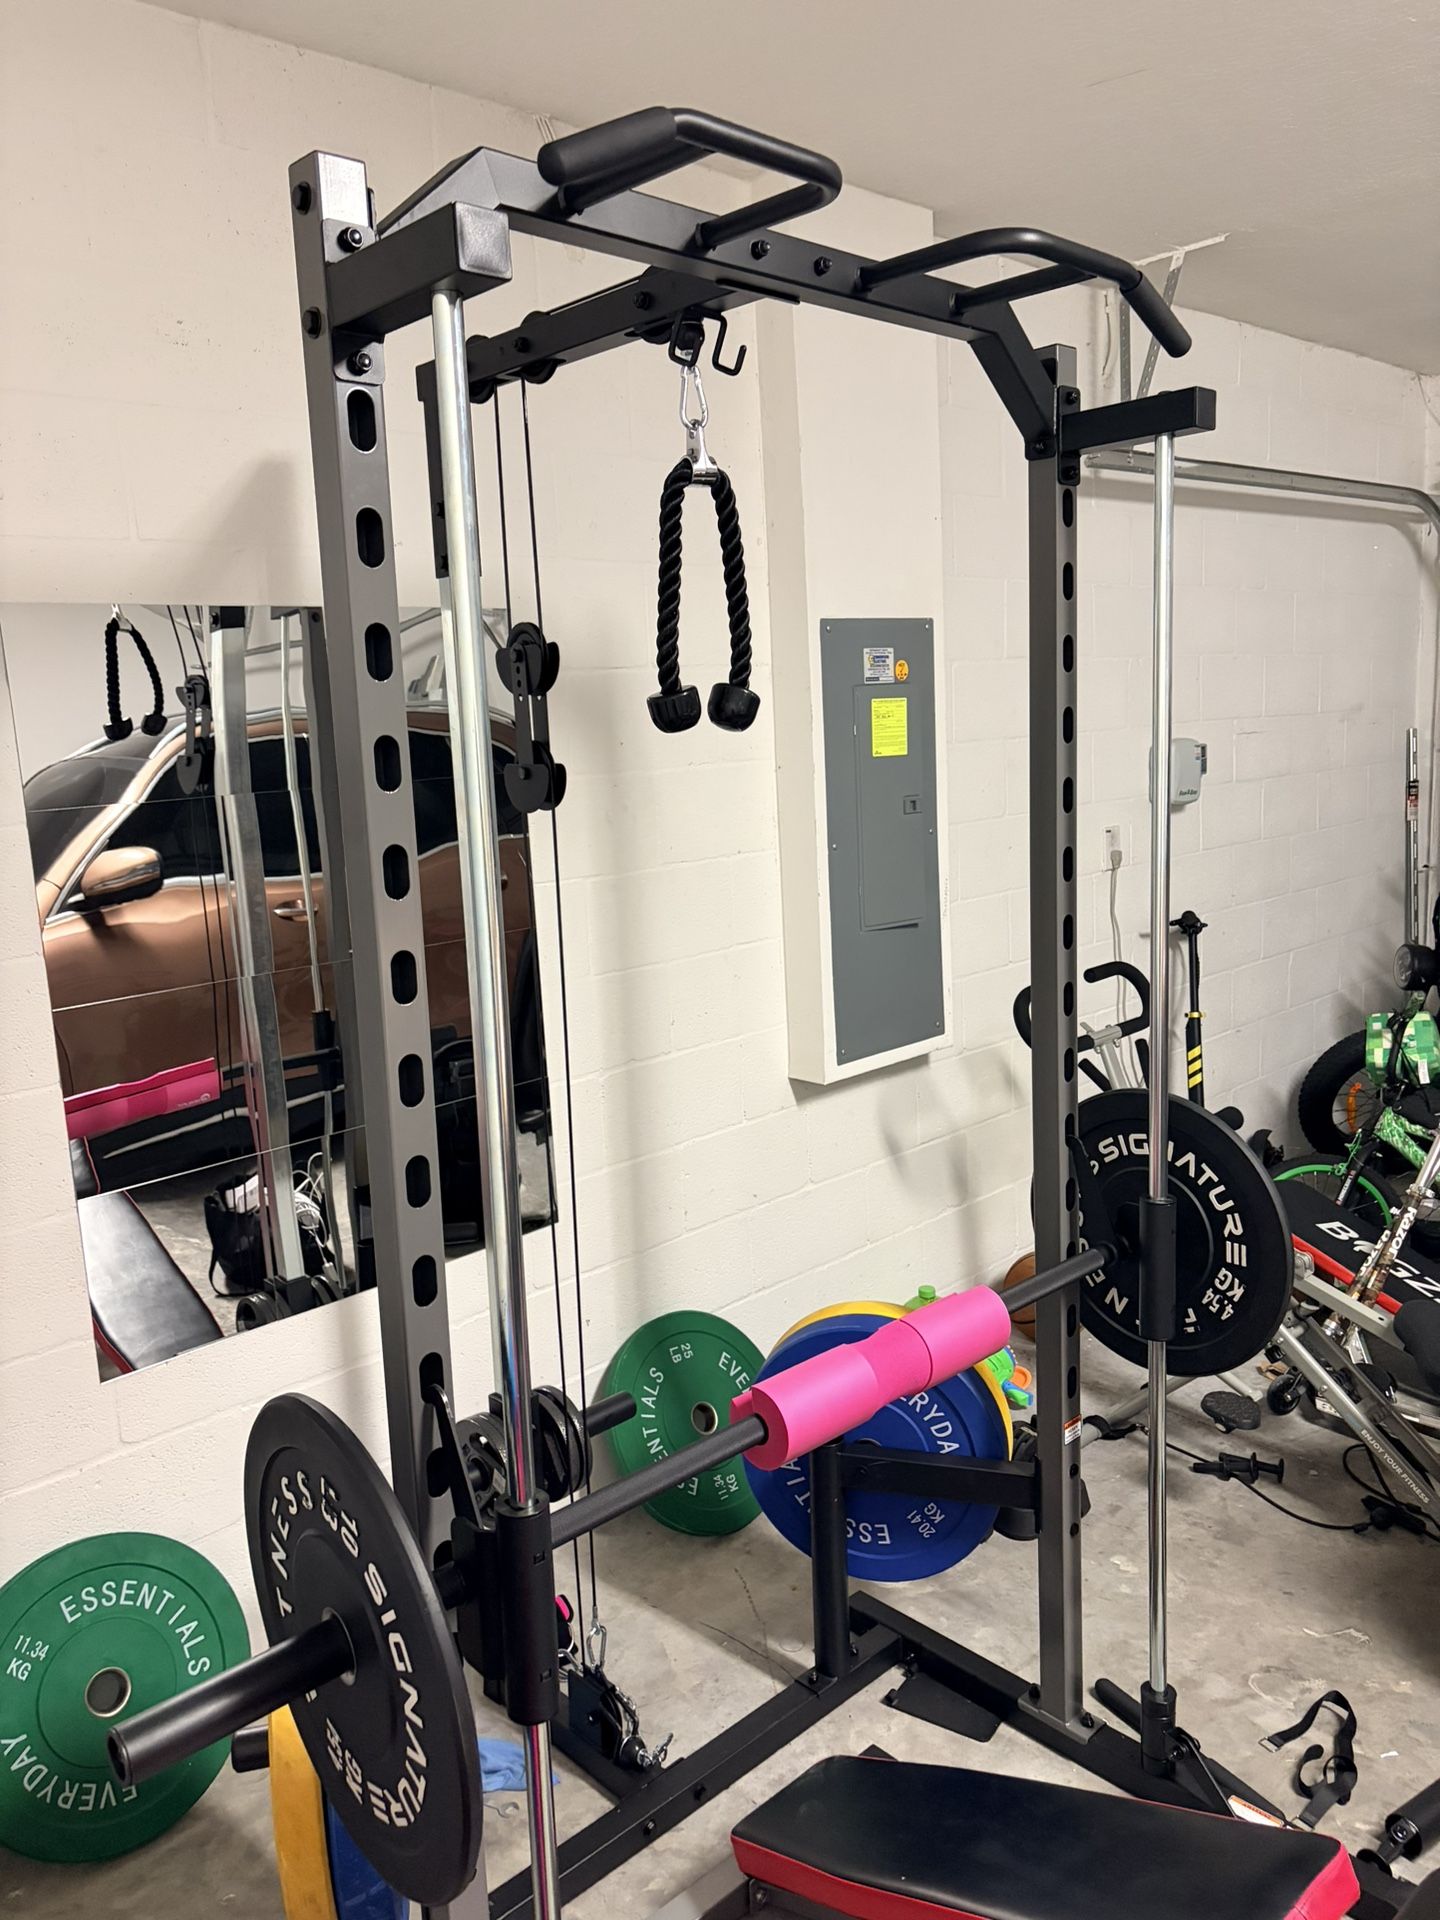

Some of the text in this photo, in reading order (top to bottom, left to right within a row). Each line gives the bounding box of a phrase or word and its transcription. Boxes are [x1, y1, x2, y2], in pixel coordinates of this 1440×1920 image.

[1389, 1206, 1418, 1260] Razor
[1214, 1266, 1245, 1303] KG
[1201, 1287, 1234, 1321] 4.54
[669, 1346, 682, 1364] LB
[680, 1342, 694, 1360] 25
[718, 1351, 751, 1395] EVE
[726, 1473, 739, 1493] KG
[1360, 1428, 1431, 1504] ENJOY YOUR FITNESS
[713, 1473, 729, 1500] 11.34
[906, 1509, 937, 1539] 20.41
[923, 1502, 946, 1524] KG
[340, 1509, 360, 1558] 10
[59, 1579, 211, 1677] ESSENTIALS
[13, 1634, 50, 1662] 11.34
[6, 1656, 32, 1682] KG
[363, 1562, 427, 1828] SIGNATURE
[0, 1732, 138, 1812] EVERYDAY
